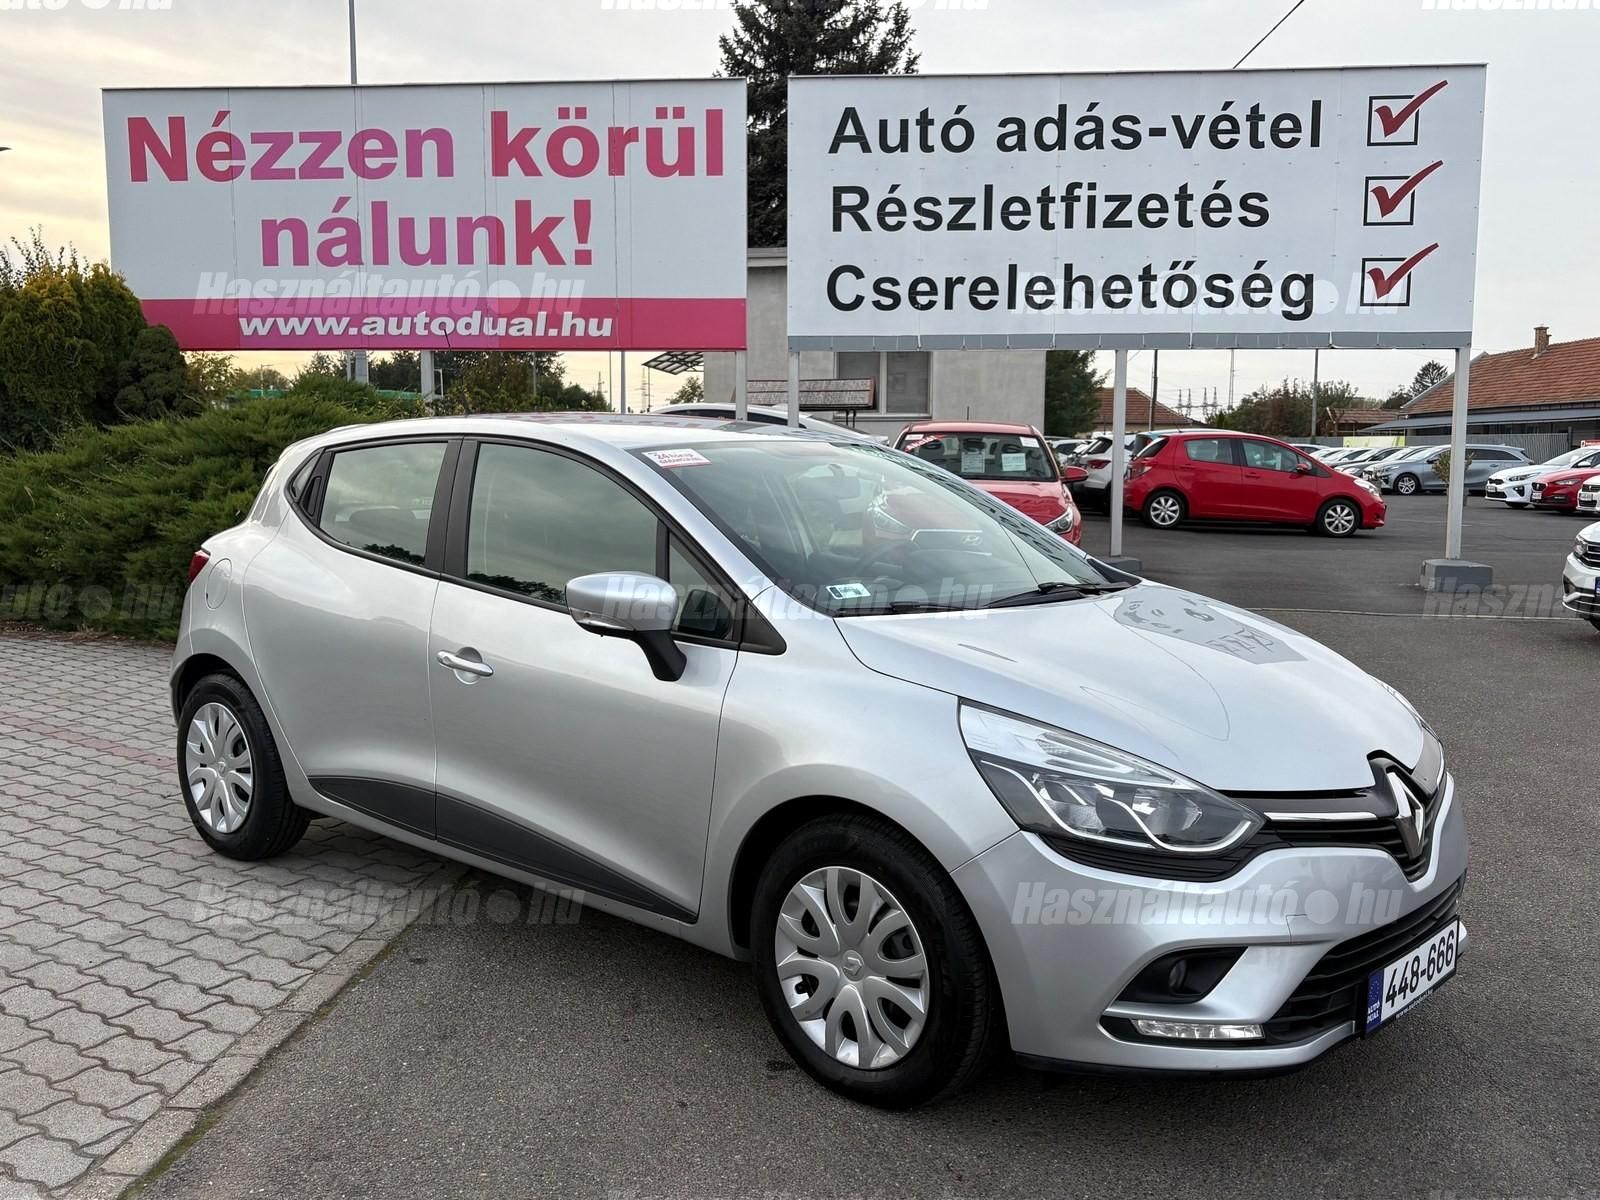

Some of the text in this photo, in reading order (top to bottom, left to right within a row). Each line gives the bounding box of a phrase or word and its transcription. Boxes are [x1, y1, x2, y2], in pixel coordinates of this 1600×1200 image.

[127, 106, 724, 182] Nézzen körül
[828, 99, 1322, 154] Autó adás-vétel
[262, 197, 592, 267] nálunk!
[832, 179, 1270, 233] Részletfizetés
[826, 260, 1315, 322] Cserelehetőség
[239, 310, 613, 338] www.autodual.hu
[1385, 929, 1455, 1009] 448-666
